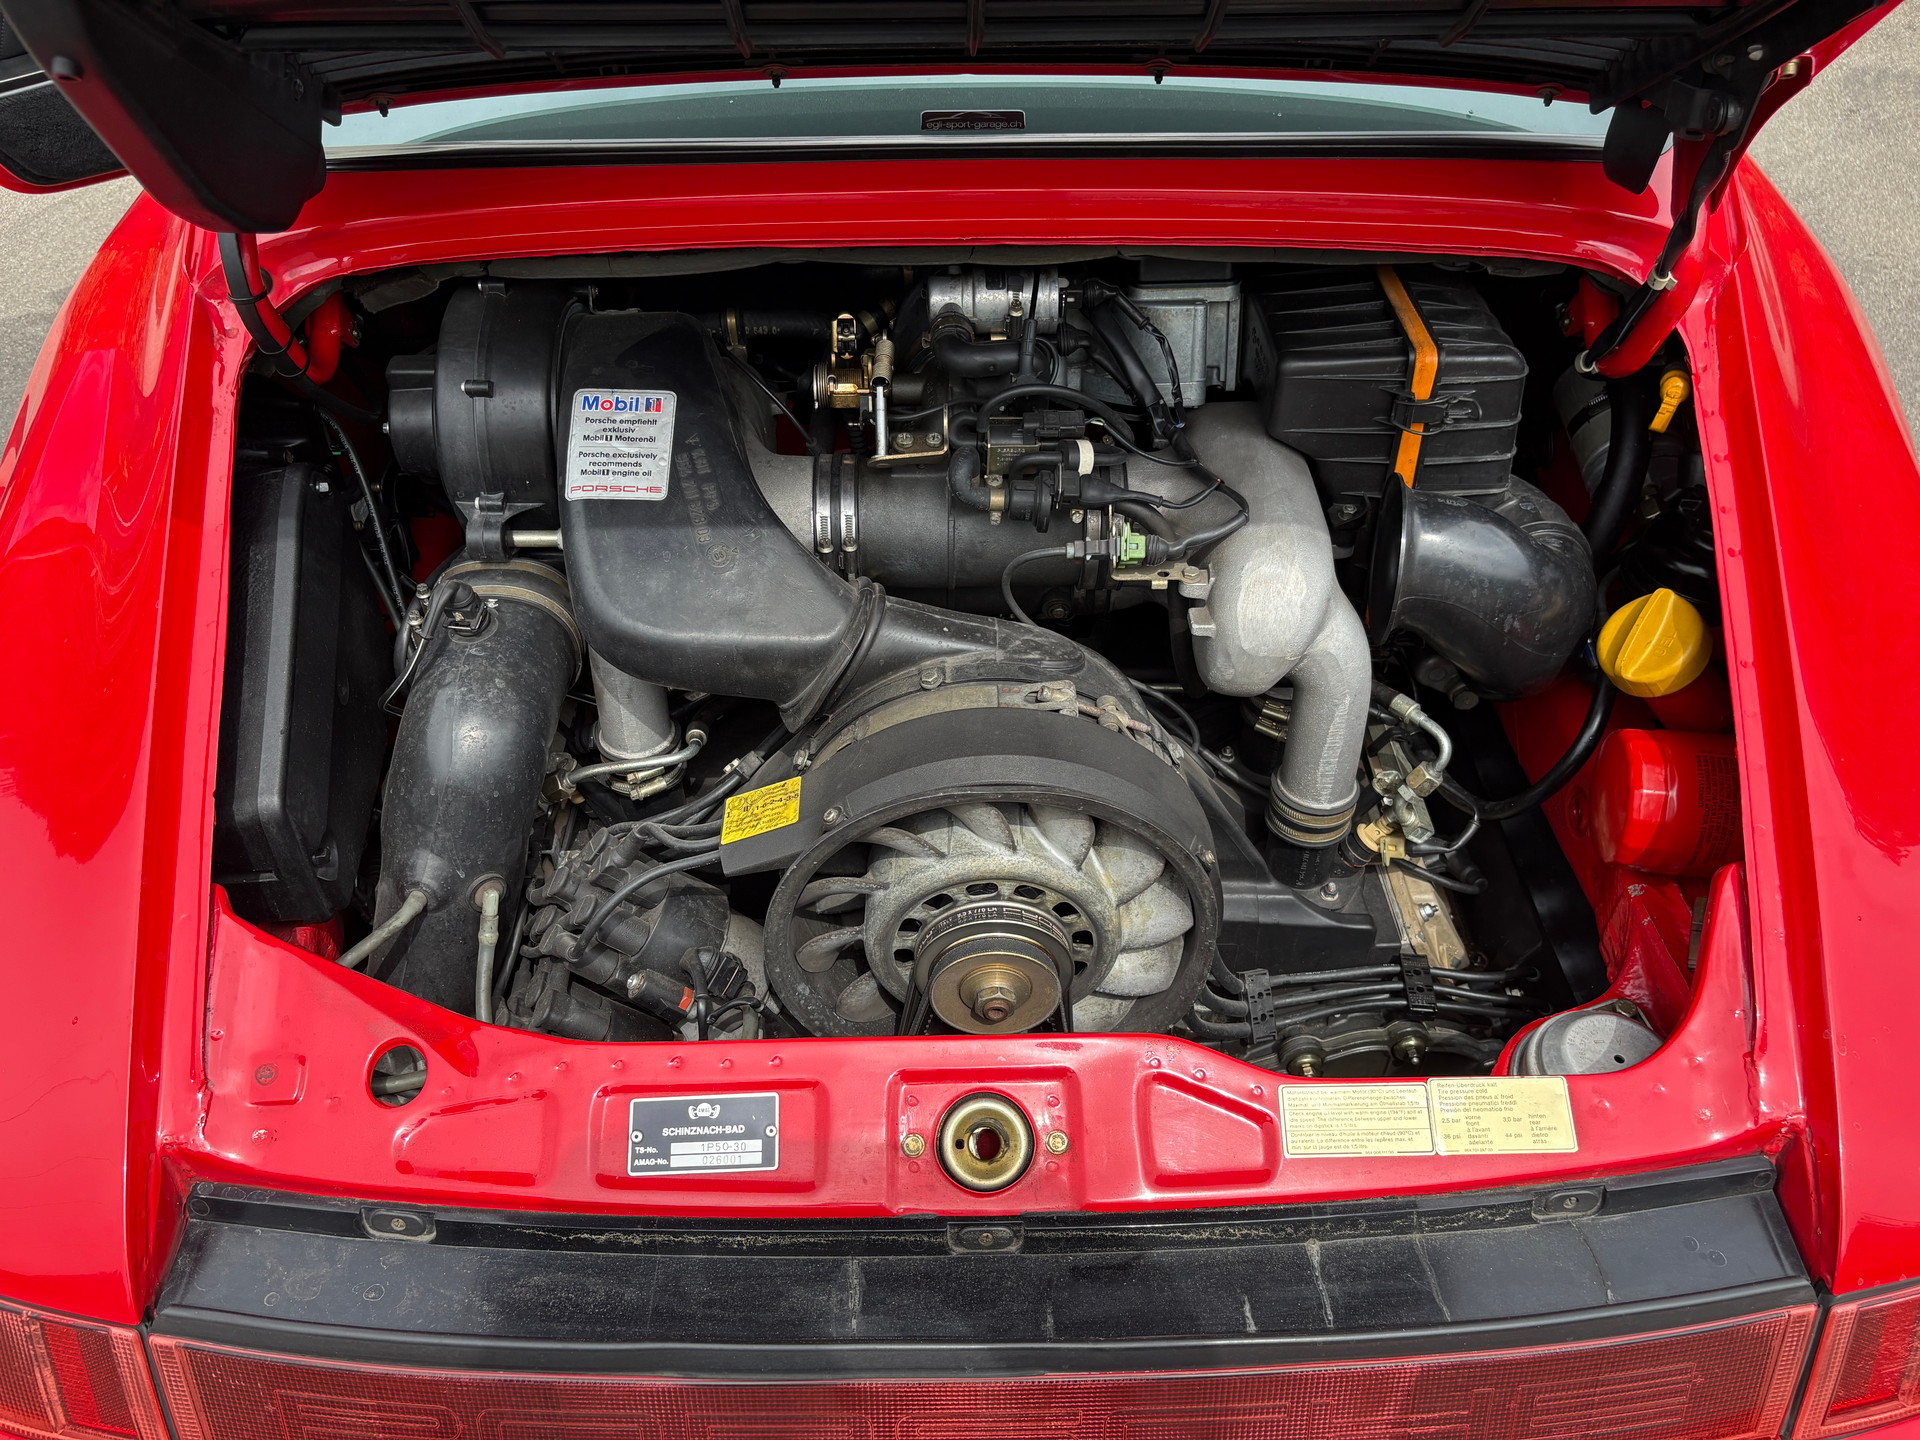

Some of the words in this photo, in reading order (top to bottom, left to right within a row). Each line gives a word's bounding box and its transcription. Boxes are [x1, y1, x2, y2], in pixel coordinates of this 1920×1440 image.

[927, 121, 1021, 130] egli-sport-garage.ch
[582, 396, 639, 412] Mobil
[570, 485, 662, 493] PORSCHE
[662, 1125, 745, 1136] SCHINZNACH-BAD
[702, 1155, 742, 1165] 026001
